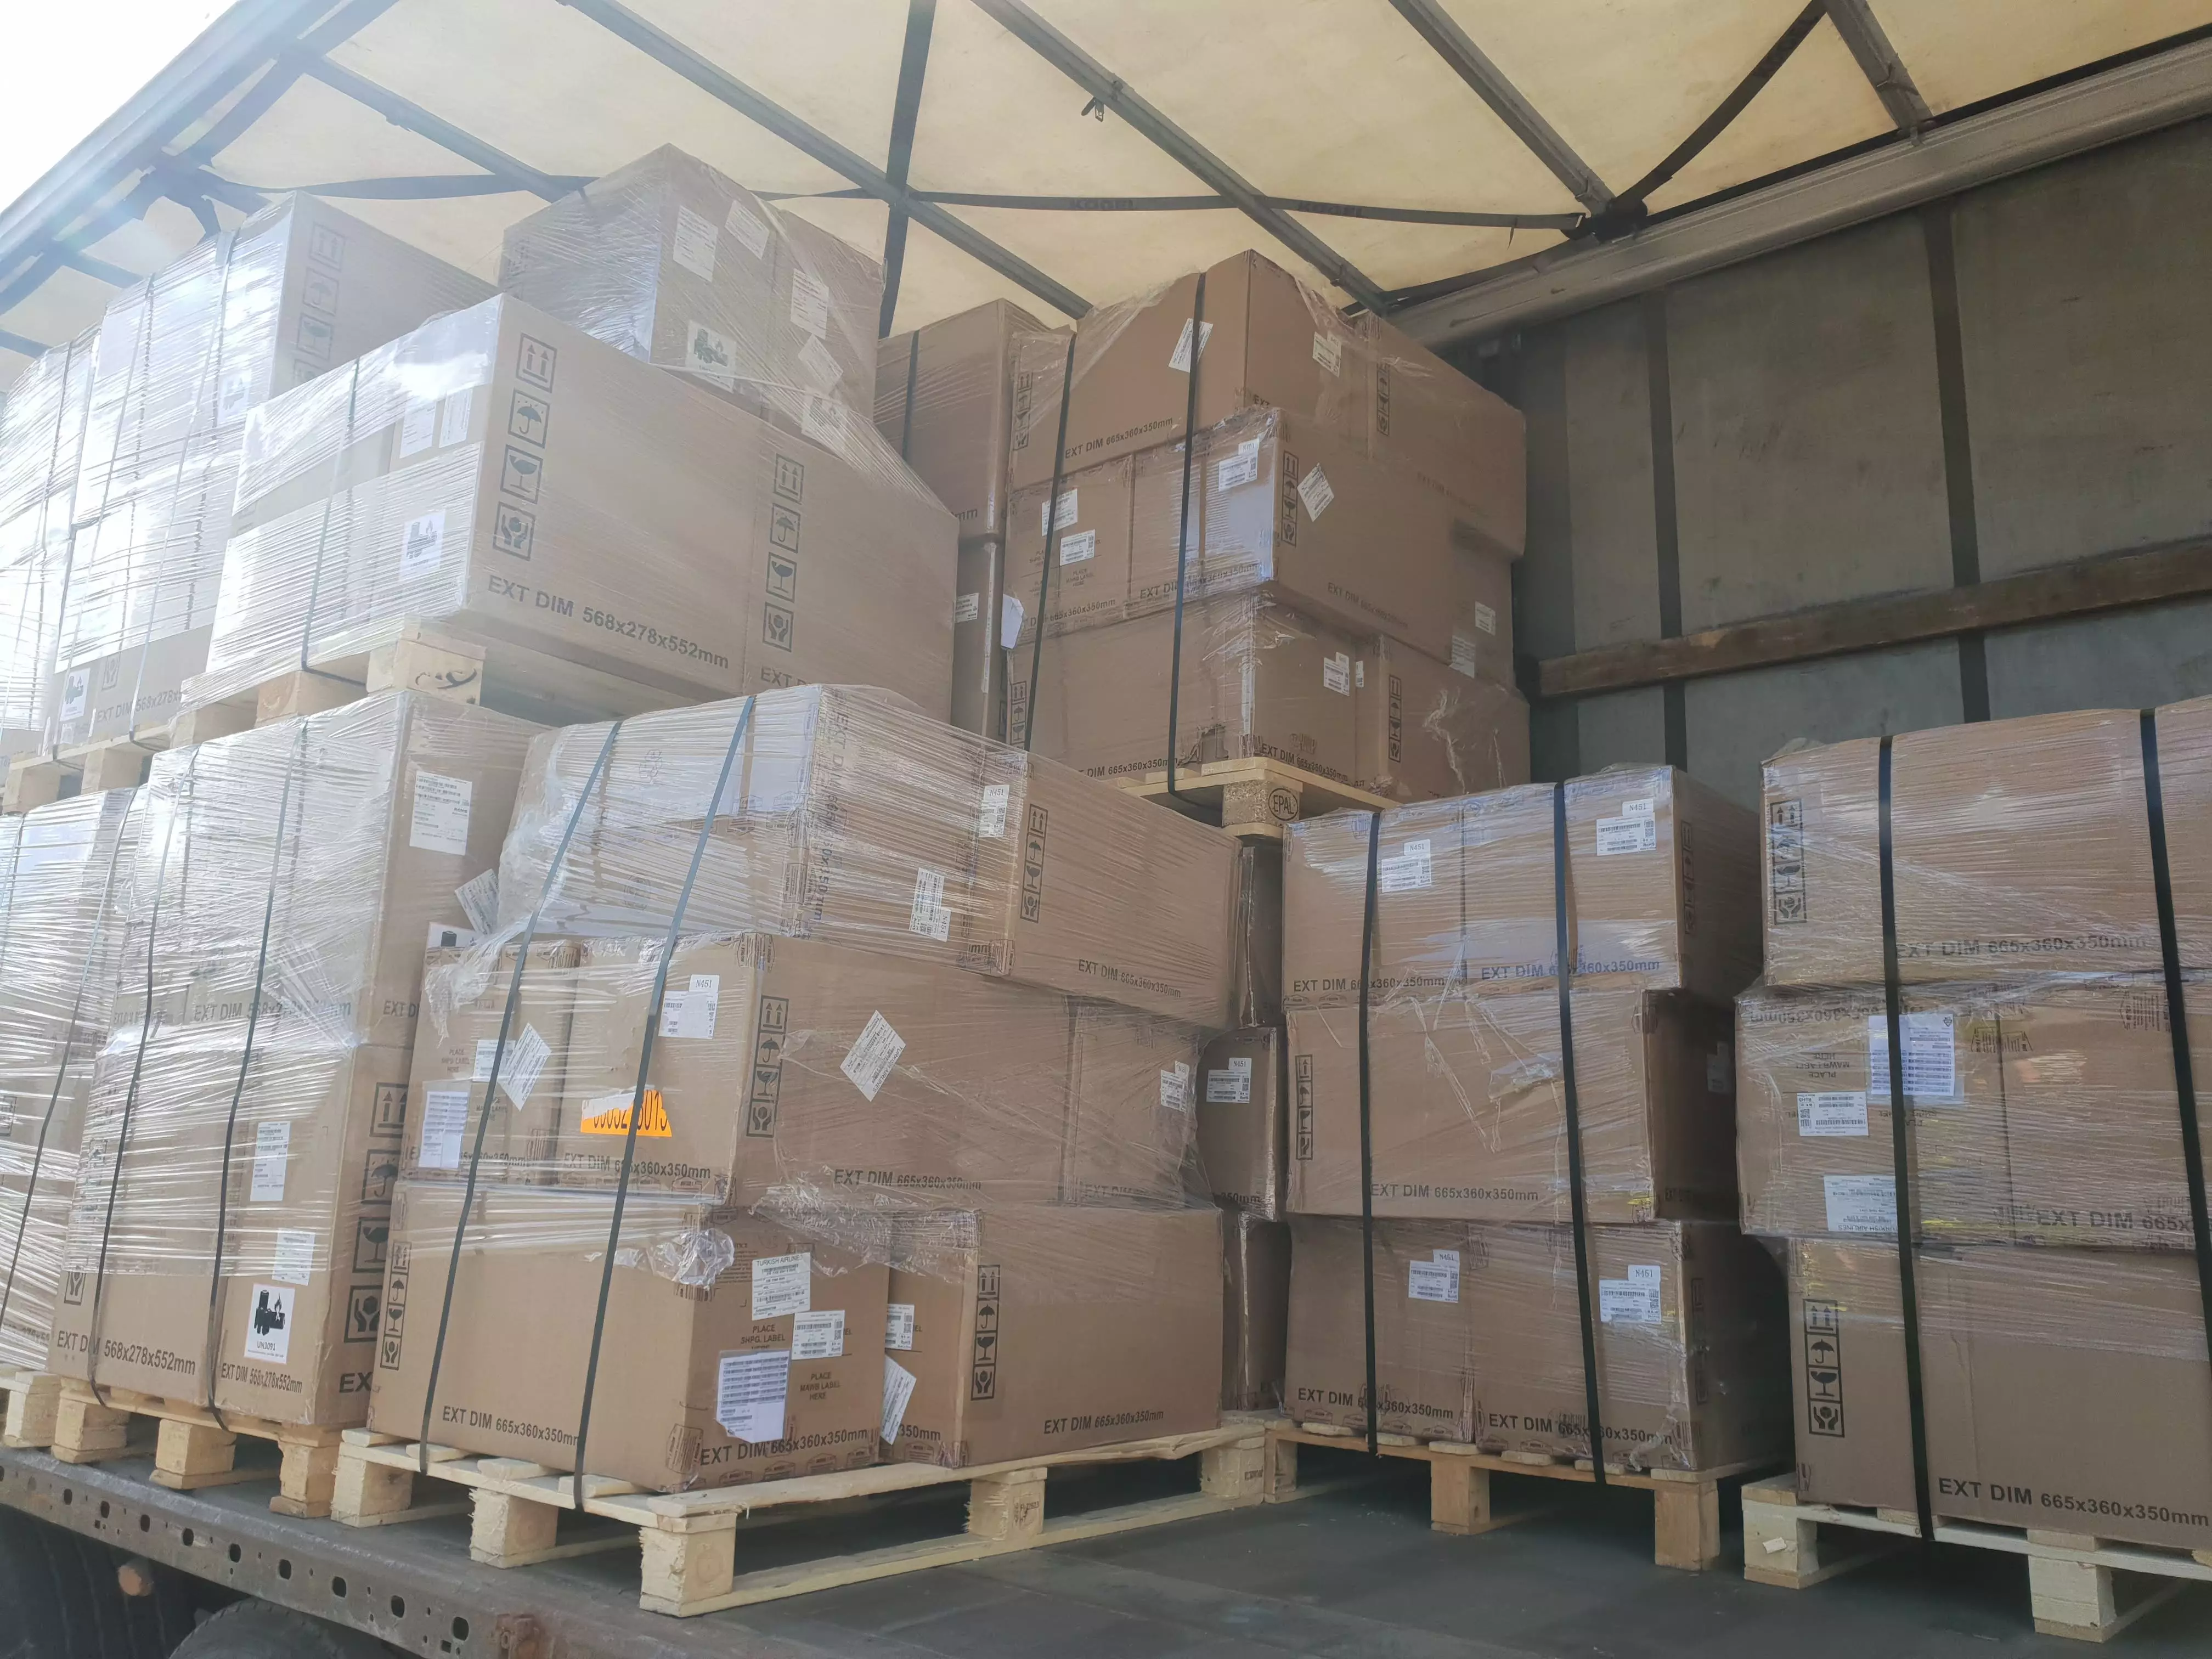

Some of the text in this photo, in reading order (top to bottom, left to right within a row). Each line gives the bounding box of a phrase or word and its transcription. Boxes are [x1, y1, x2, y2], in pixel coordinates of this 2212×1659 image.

[1065, 417, 1173, 459] EXT DIM 665x360x350mm
[1140, 585, 1160, 599] EXT
[488, 575, 729, 669] EXT DIM 568x278x552mm
[761, 667, 793, 687] EXT
[97, 707, 114, 723] EXT
[1262, 743, 1277, 757] EXT
[1280, 750, 1295, 765] DIM
[1087, 766, 1105, 778] DIM
[1273, 794, 1295, 815] EPAL
[1629, 803, 1646, 811] N451
[1410, 843, 1424, 851] N451
[1942, 939, 1980, 956] DIM
[1079, 959, 1181, 998] EXT DIM 665x360x350mm
[1482, 966, 1510, 980] EXT
[1515, 964, 1543, 978] DIM
[696, 979, 712, 988] N451
[1294, 979, 1318, 992] EXT
[1323, 978, 1346, 991] DIM
[194, 1003, 217, 1022] EXT
[219, 1002, 242, 1018] DIM
[384, 1000, 405, 1017] EXT
[564, 1153, 584, 1169] EXT
[589, 1155, 610, 1171] DIM
[834, 1169, 863, 1185] EXT
[868, 1171, 893, 1186] DIM
[1370, 1183, 1538, 1201] EXT DIM 665x360x350mm
[2037, 1209, 2193, 1232] EXT DIM 665x
[757, 1257, 779, 1267] TURKISH
[752, 1324, 776, 1334] PLACE
[256, 1340, 276, 1351] UN3091
[764, 1334, 786, 1343] LABEL
[57, 1330, 78, 1350] EXT
[104, 1339, 196, 1376] 568x278x552mm
[221, 1362, 303, 1394] EXT DIM 568x278x552mm
[339, 1371, 374, 1393] EX
[810, 1372, 832, 1381] PLACE
[800, 1380, 841, 1392] MAWB LABEL
[809, 1392, 826, 1401] HERE
[1298, 1387, 1325, 1402] EXT
[1329, 1391, 1354, 1407] DIM
[442, 1406, 467, 1424] EXT
[470, 1410, 493, 1430] DIM
[1043, 1409, 1164, 1434] EXT DIM 665x360x350mm
[1488, 1413, 1673, 1445] EXT DIM 665x60x350mm
[700, 1429, 867, 1466] EXT DIM 665x360x350mm
[1938, 1477, 2210, 1527] EXT DIM 665x360x350mm
